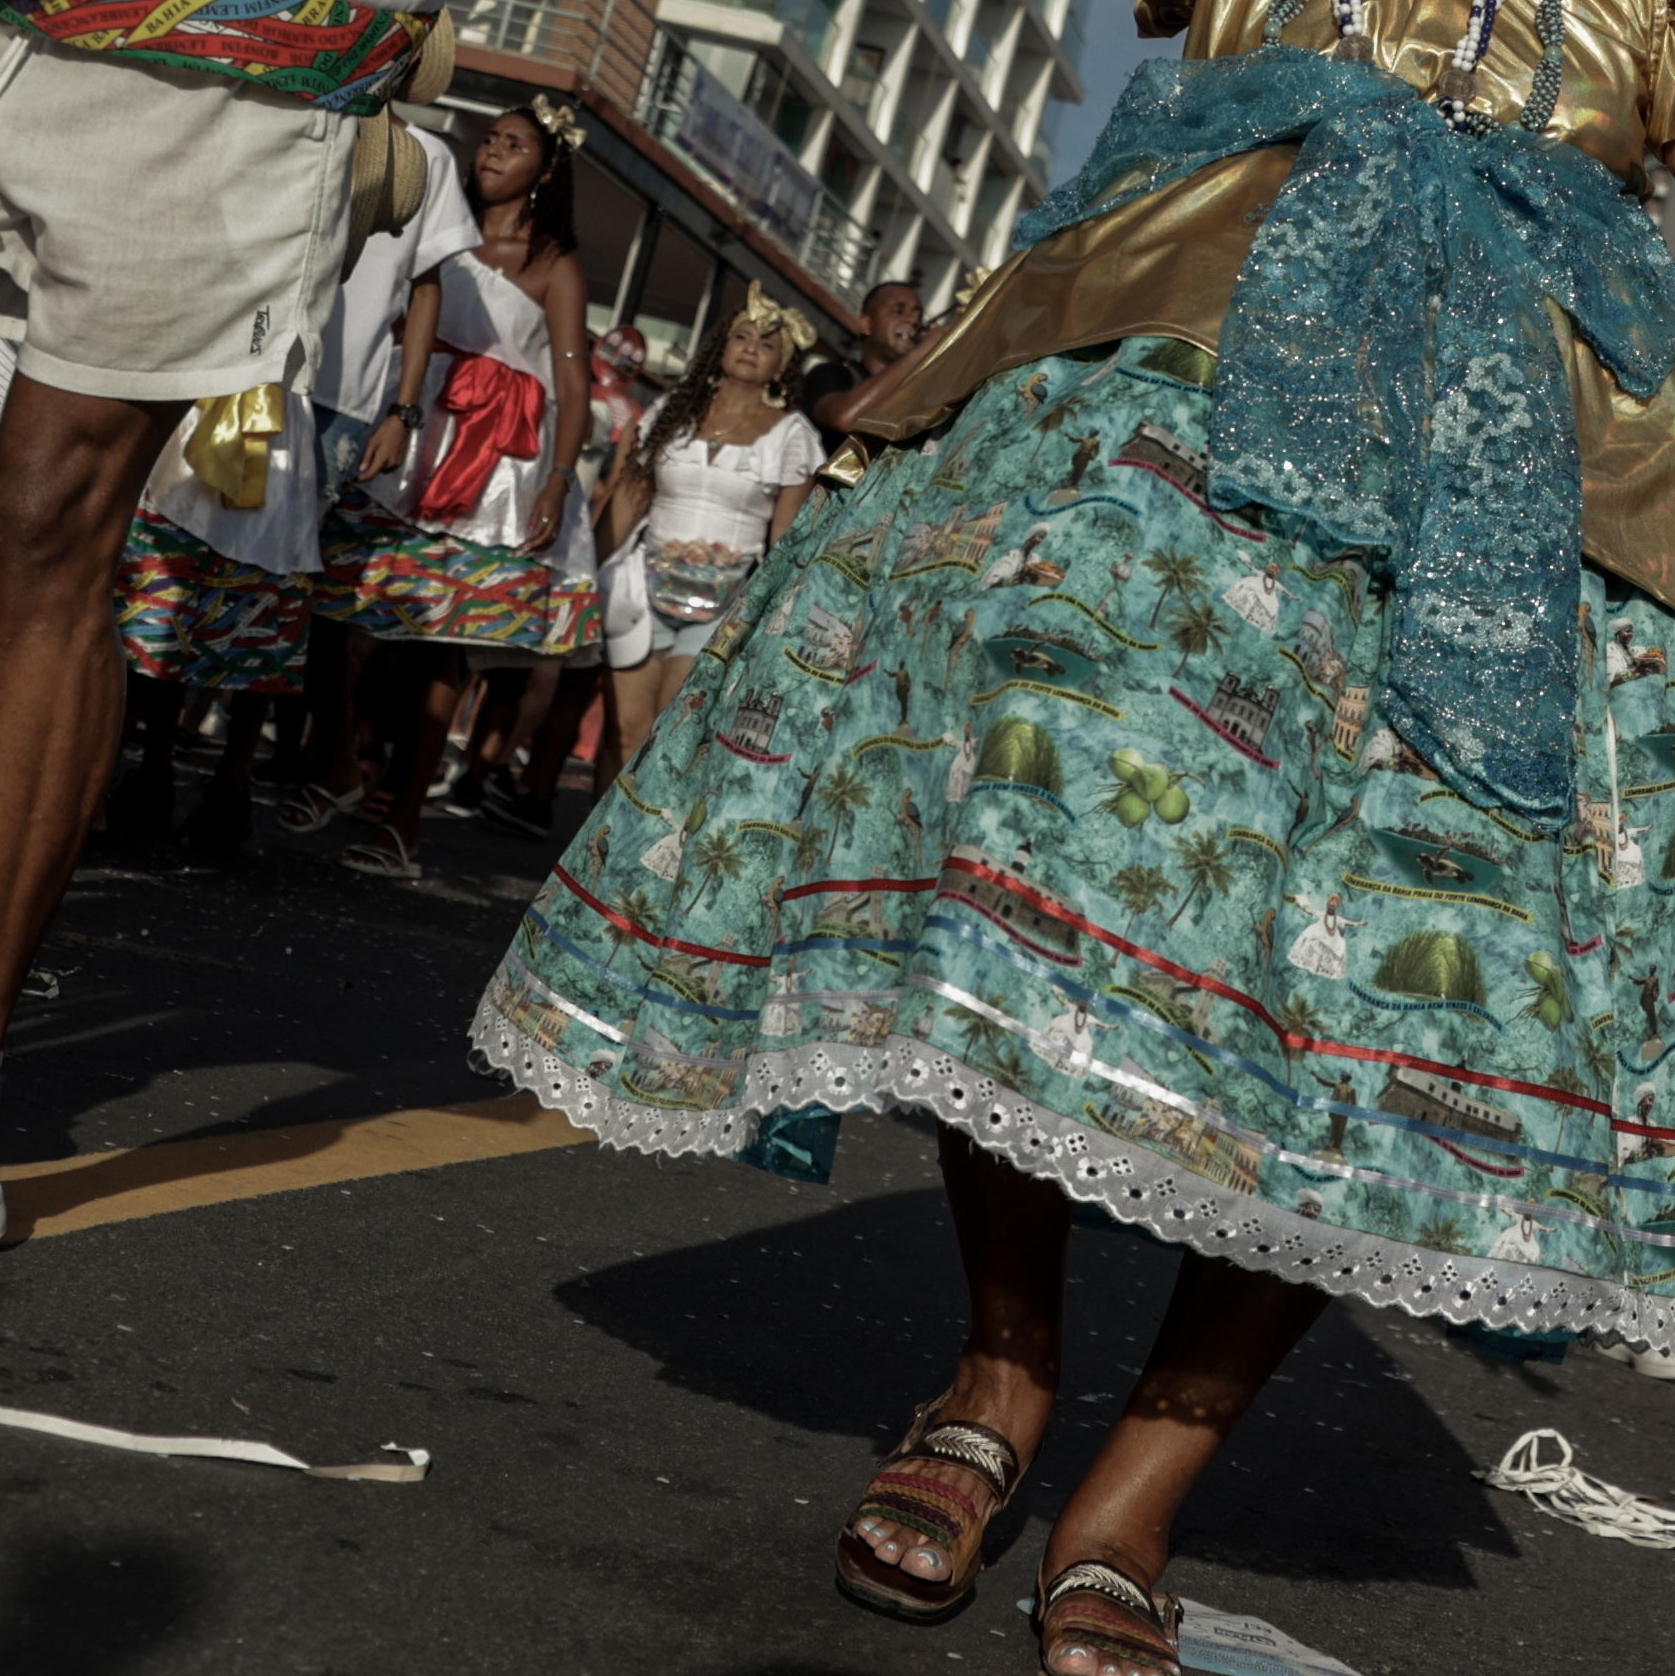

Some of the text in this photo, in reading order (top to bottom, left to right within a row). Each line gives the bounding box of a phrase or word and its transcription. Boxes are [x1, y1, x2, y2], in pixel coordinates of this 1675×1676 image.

[260, 22, 340, 46] DO SENHOR
[220, 39, 280, 62] BONFIM
[339, 49, 362, 71] DO
[1149, 377, 1160, 386] DA
[1160, 379, 1183, 391] BAHIA
[1019, 681, 1121, 718] DO FORTE LEMBRANÇA DA BAHIA
[991, 782, 1010, 791] BEM
[1011, 783, 1040, 797] VINDOS
[1044, 794, 1079, 824] SALVADOR
[1265, 839, 1275, 849] DA
[1344, 874, 1530, 922] LEMBRANÇA DA BAHIA PRAIA DO FORTE LEMBRANÇA DA BAHIA
[1347, 982, 1391, 1010] LEMBRANÇA
[1391, 1002, 1402, 1011] DA
[1403, 1002, 1426, 1011] BAHIA
[1427, 1002, 1444, 1010] BEM
[1445, 1002, 1468, 1011] VINDOS
[1472, 1005, 1506, 1033] SALVADOR
